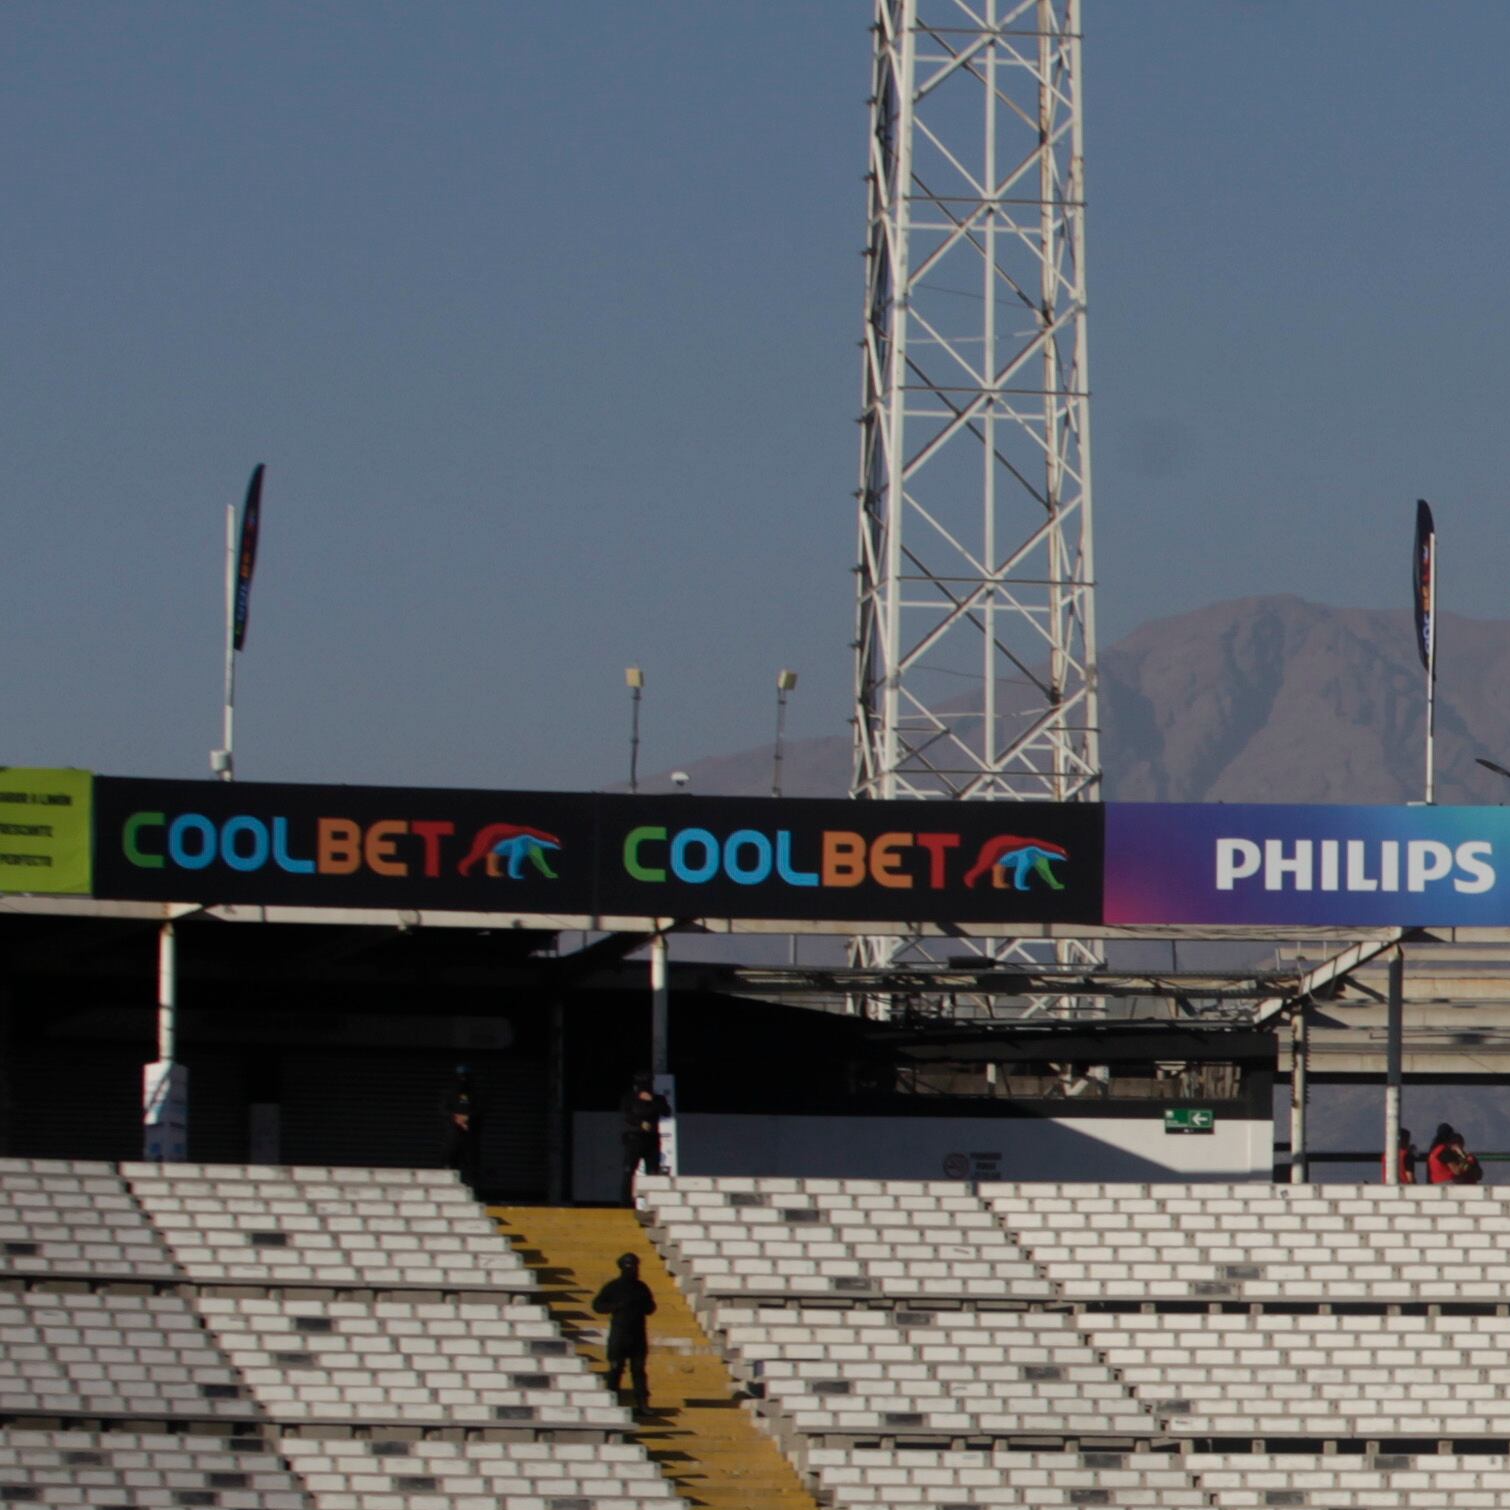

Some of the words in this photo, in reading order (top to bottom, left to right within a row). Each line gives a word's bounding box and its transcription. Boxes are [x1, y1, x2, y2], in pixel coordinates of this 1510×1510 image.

[122, 811, 455, 878] COOLBET
[623, 826, 960, 889] COOLBET
[1215, 838, 1496, 895] PHILIPS
